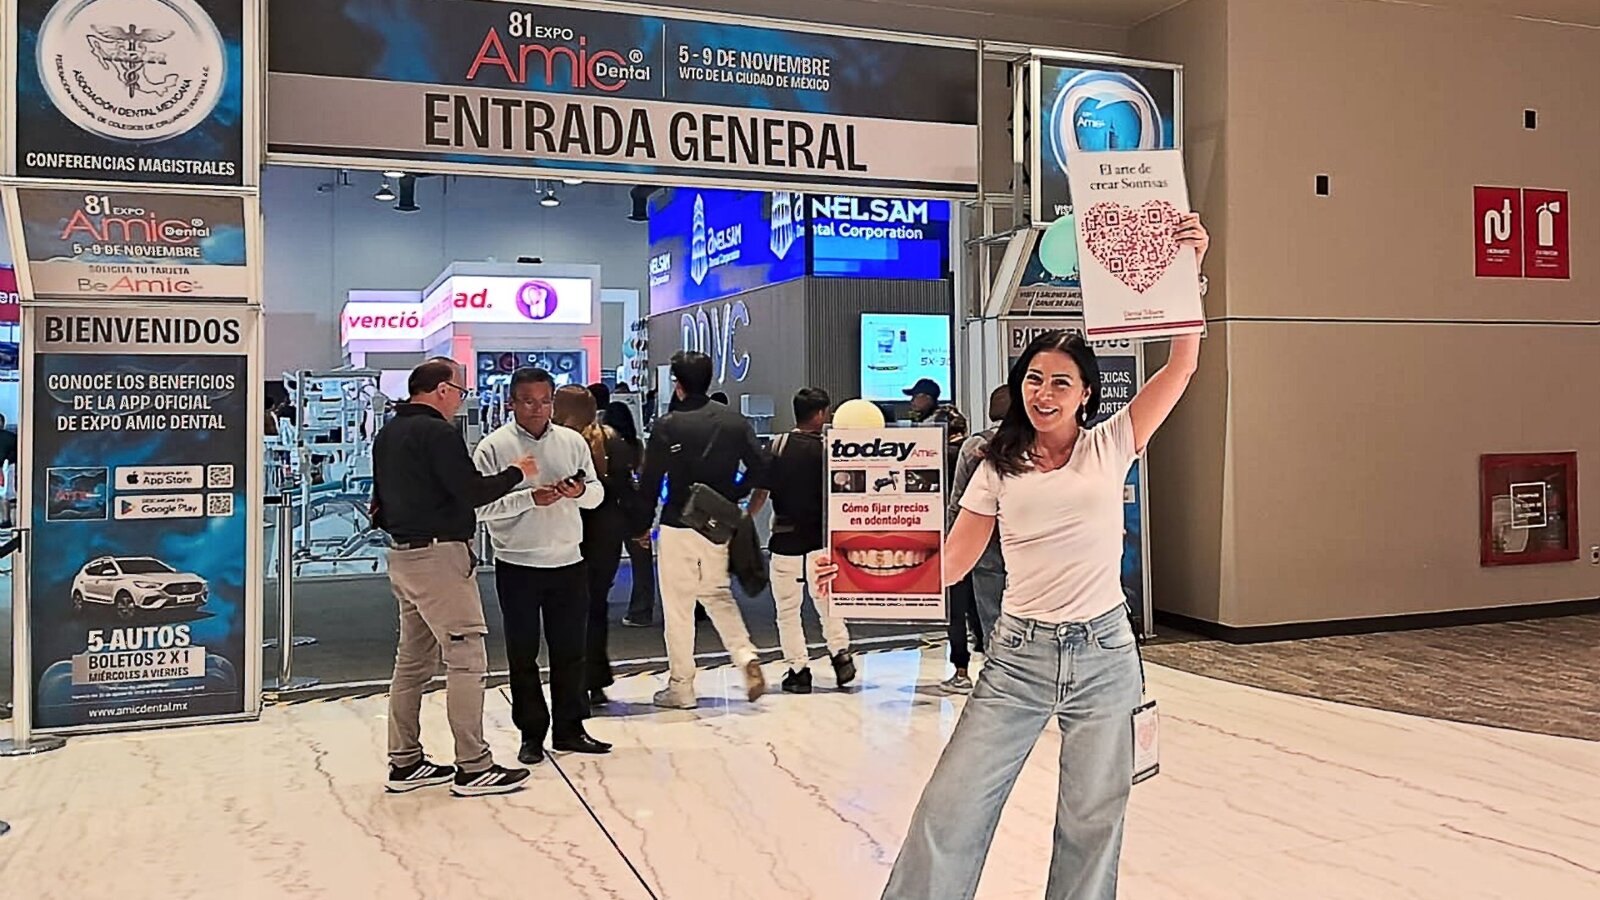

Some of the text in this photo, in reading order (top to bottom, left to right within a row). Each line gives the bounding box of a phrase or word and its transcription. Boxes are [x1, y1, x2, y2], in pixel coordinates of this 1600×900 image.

[509, 11, 574, 41] 81 EXPO
[465, 26, 627, 93] Amic
[678, 45, 689, 64] 5
[702, 47, 712, 66] 9
[717, 49, 736, 68] DE
[740, 51, 830, 77] NOVIEMBRE
[596, 62, 651, 81] Dental
[678, 66, 830, 92] WTC DE LA CIUDAD DE MÉXICO
[117, 107, 157, 118] DENTAL
[156, 79, 193, 113] MEXICANA
[424, 91, 868, 172] ENTRADA GENERAL
[26, 152, 236, 176] CONFERENCIAS MAGISTRALES
[1099, 163, 1151, 175] El arte de
[1089, 178, 1169, 191] crear Sonrisas
[84, 194, 145, 216] 81 EXPO
[60, 208, 192, 244] Amic
[164, 226, 210, 238] Dental
[838, 222, 923, 240] Corporation
[104, 244, 122, 257] DE
[123, 244, 201, 258] NOVIEMBRE
[135, 266, 148, 274] TU
[45, 316, 240, 345] BIENVENIDOS
[48, 374, 235, 390] CONOCE LOS BENEFICIOS
[1100, 386, 1129, 398] CANJE
[73, 394, 211, 410] DE LA APP OFICIAL
[57, 414, 226, 431] DE EXPO AMIC DENTAL
[831, 438, 917, 462] today
[143, 475, 193, 485] App Store
[141, 504, 177, 515] Google
[842, 502, 930, 517] Cómo fijar precios
[850, 516, 862, 526] en
[87, 624, 191, 653] 5 AUTOS
[88, 649, 190, 670] BOLETOS 2 X 1
[88, 666, 190, 683] MIÉRCOLES A VIERNES
[88, 701, 188, 718] www.amicdental.mx
